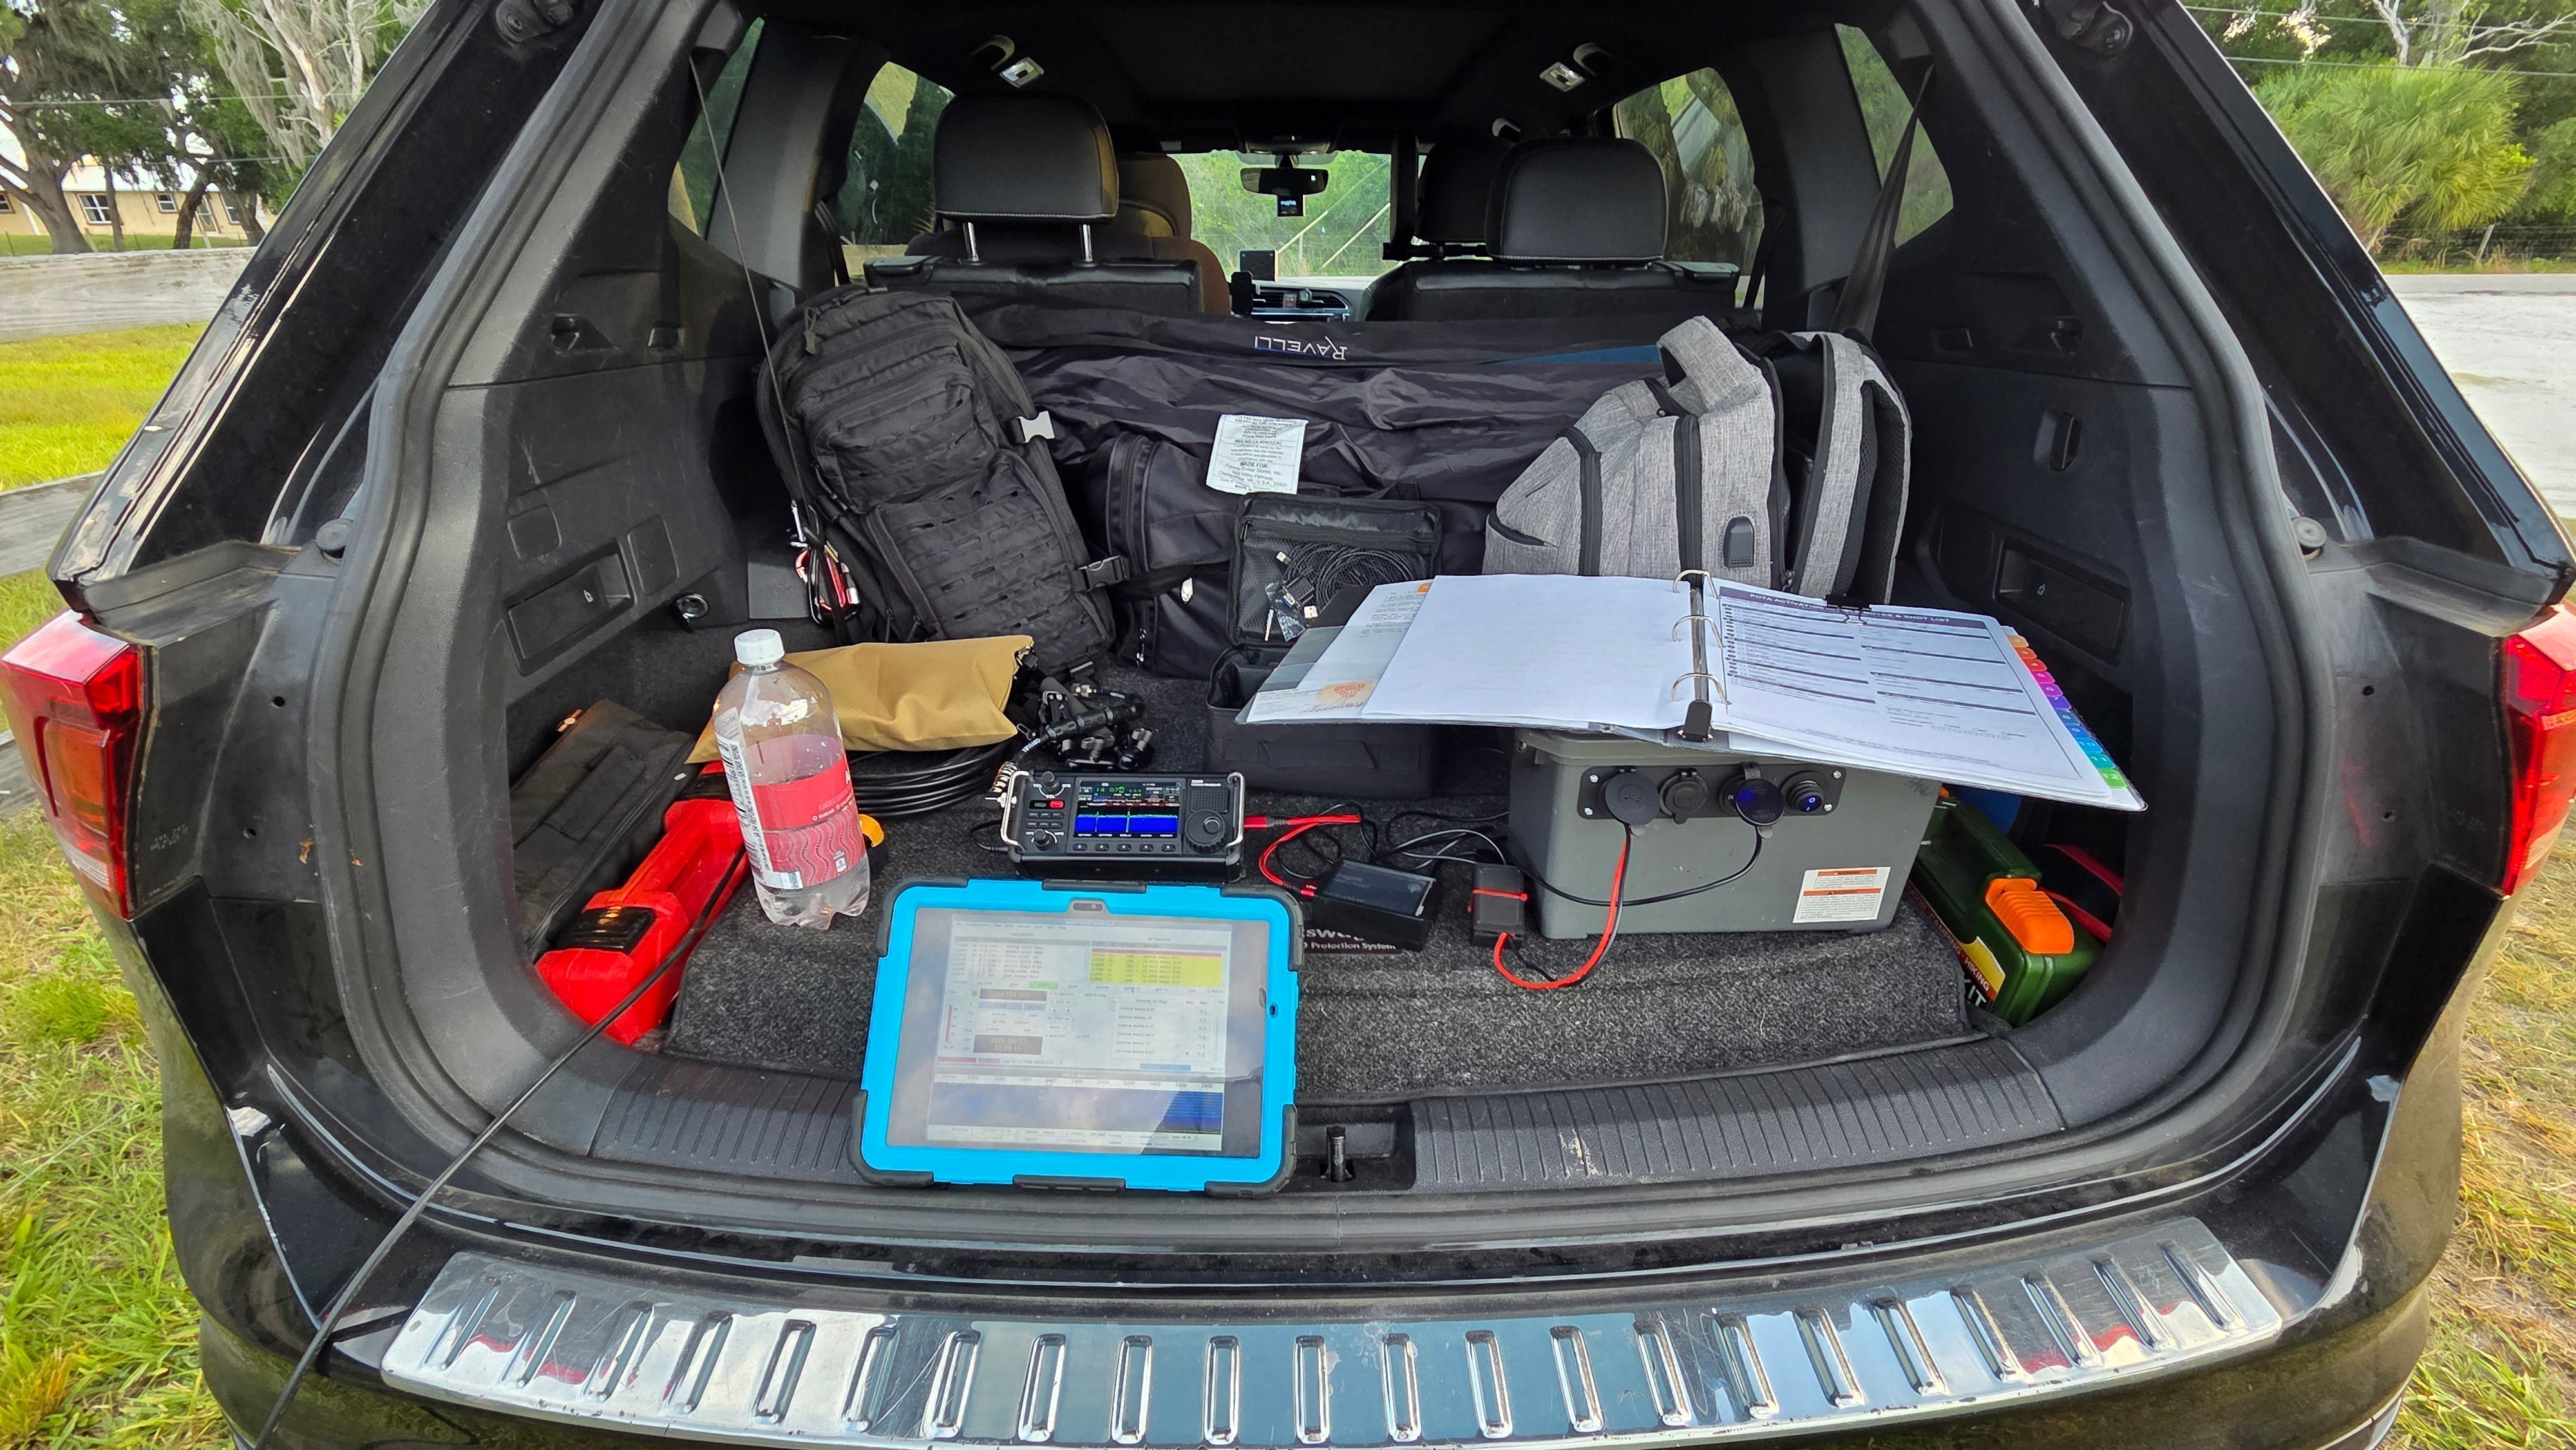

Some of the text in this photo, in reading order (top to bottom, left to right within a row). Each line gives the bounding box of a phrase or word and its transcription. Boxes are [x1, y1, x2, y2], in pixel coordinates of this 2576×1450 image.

[1255, 336, 1347, 360] RAVELLI
[818, 808, 835, 819] SUGAR
[1311, 941, 1360, 950] Protection
[1964, 957, 1990, 992] HIKING
